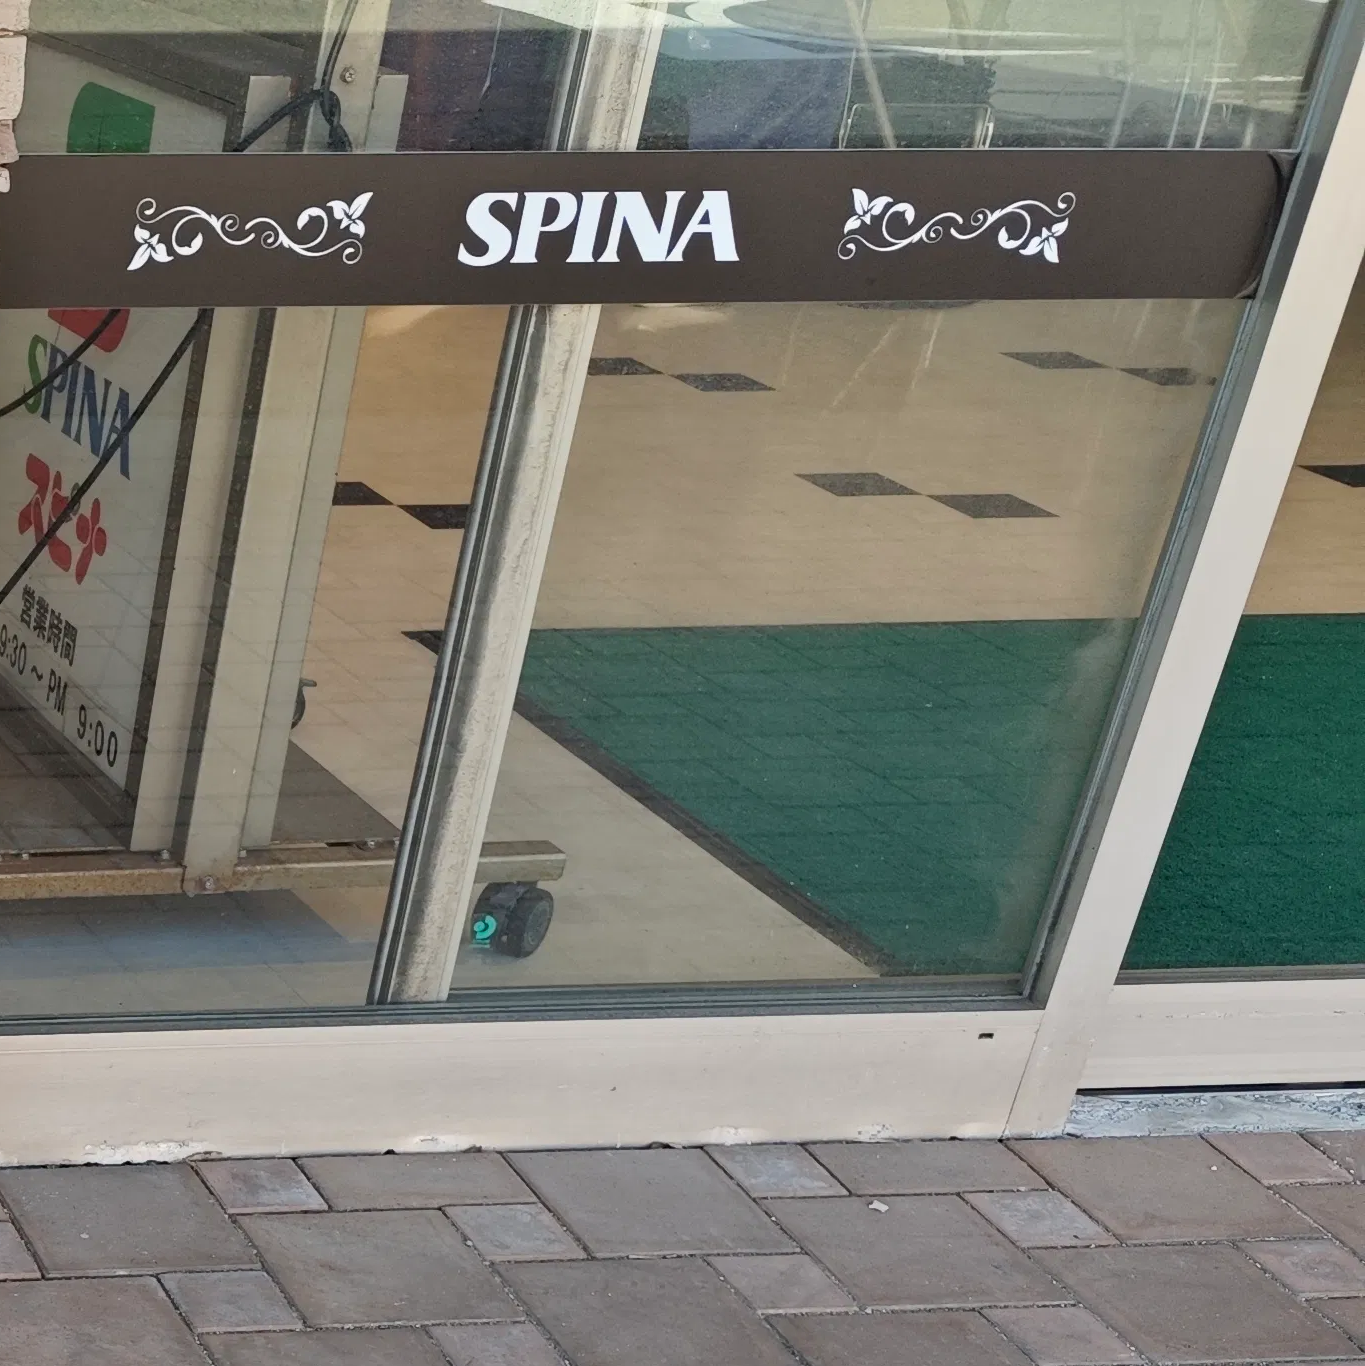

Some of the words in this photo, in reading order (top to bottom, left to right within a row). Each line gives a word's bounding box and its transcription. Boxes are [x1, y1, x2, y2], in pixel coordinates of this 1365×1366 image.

[457, 190, 740, 267] SPINA
[24, 334, 131, 481] SPINA
[20, 584, 78, 667] 営業時間
[0, 624, 27, 676] 9:30
[46, 668, 68, 716] PM
[77, 704, 118, 768] 9:00
